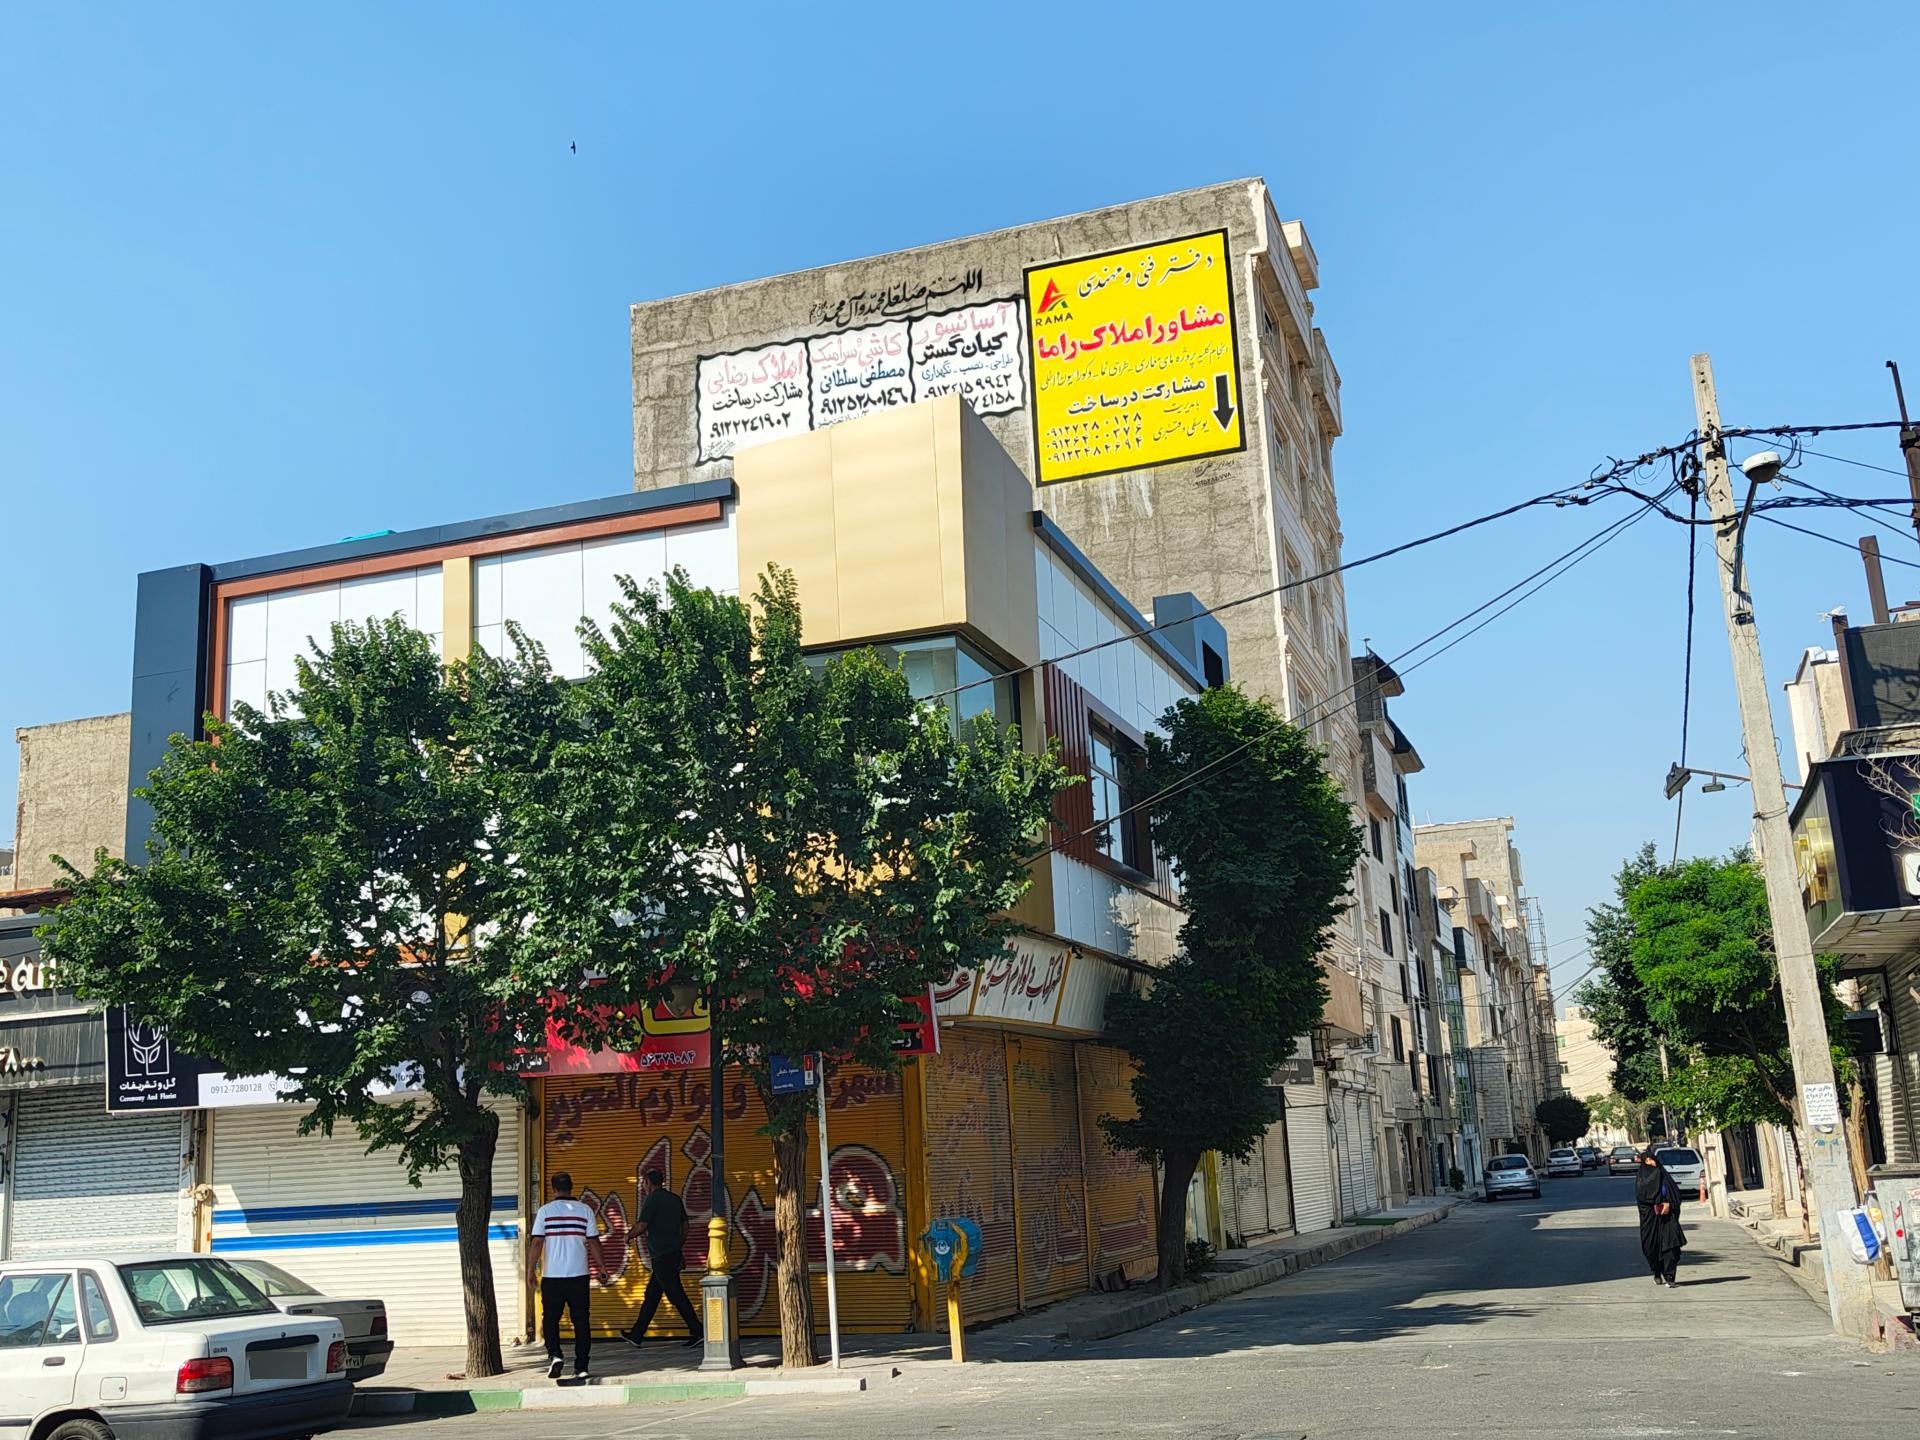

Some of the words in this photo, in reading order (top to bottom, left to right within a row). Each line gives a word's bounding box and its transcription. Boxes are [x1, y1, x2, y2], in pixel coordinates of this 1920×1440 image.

[1125, 271, 1131, 284] و
[1136, 256, 1155, 288] فنی
[1158, 249, 1213, 285] دفتر
[915, 303, 1013, 345] آسانسور
[1035, 312, 1074, 327] RAMA
[1152, 305, 1225, 344] مشاور
[961, 331, 1008, 358] کیان
[1079, 315, 1151, 351] املاک
[811, 337, 857, 370] سرامیک
[858, 332, 902, 367] کاشی
[916, 333, 964, 366] گستر
[1037, 333, 1076, 361] راما
[752, 348, 804, 384] املاک
[860, 358, 905, 388] مصطفی
[922, 360, 952, 381] نگهداری
[960, 361, 984, 375] نصب
[990, 353, 1014, 371] طراحی
[820, 367, 858, 394] سلطانی
[1143, 376, 1206, 399] مشارکت
[712, 387, 752, 411] ساخت
[745, 392, 762, 409] در
[763, 381, 803, 407] مشارکت
[1068, 394, 1120, 415] ساخت
[1122, 390, 1138, 407] در
[119, 1079, 157, 1092] تشریفات
[157, 1080, 163, 1090] و
[162, 1077, 176, 1089] گل
[210, 1083, 262, 1094] 0912-7280128
[638, 1067, 712, 1128] وازم
